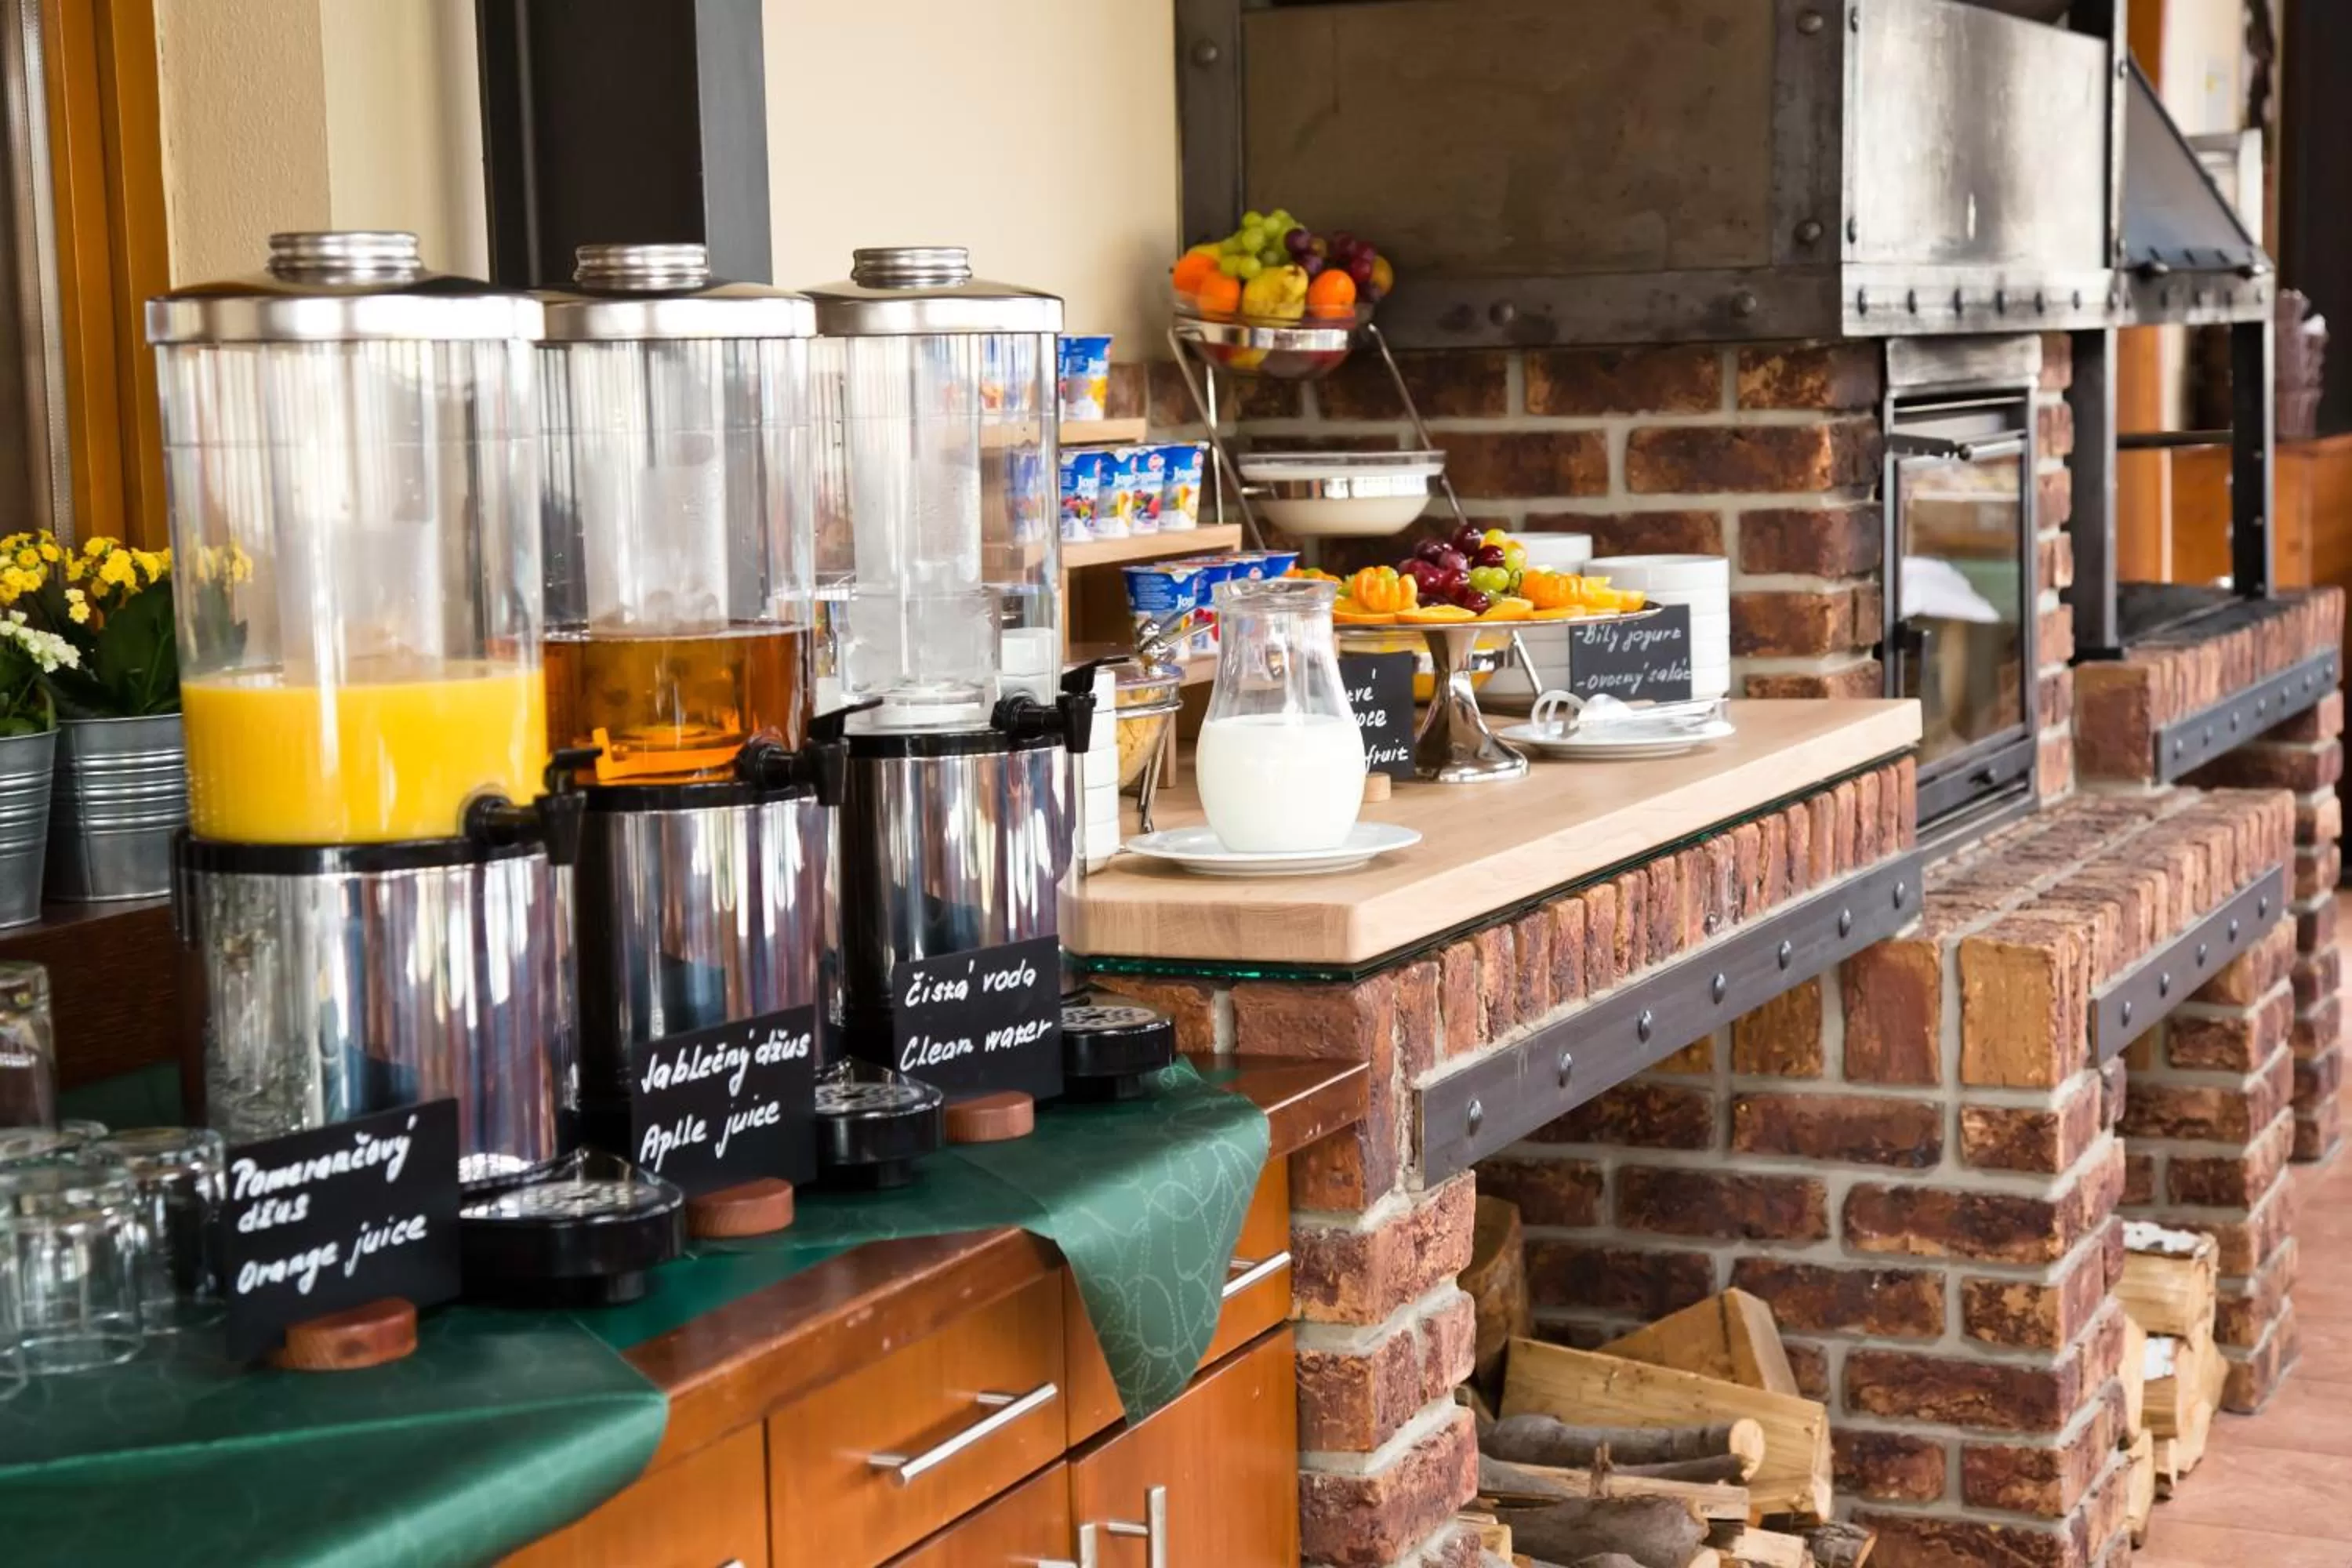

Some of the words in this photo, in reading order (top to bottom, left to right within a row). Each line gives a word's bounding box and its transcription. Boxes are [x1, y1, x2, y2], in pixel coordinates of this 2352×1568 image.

[1365, 739, 1410, 775] fruit
[905, 959, 975, 1007] Čistá
[982, 958, 1036, 993] voda
[641, 1028, 756, 1097] Jablečný
[755, 1029, 811, 1066] džus
[899, 1035, 975, 1072] Clean
[984, 1019, 1053, 1052] water
[231, 1113, 419, 1201] Pomerančový
[714, 1094, 781, 1160] juice
[238, 1242, 338, 1295] Orange
[343, 1214, 428, 1279] juice
